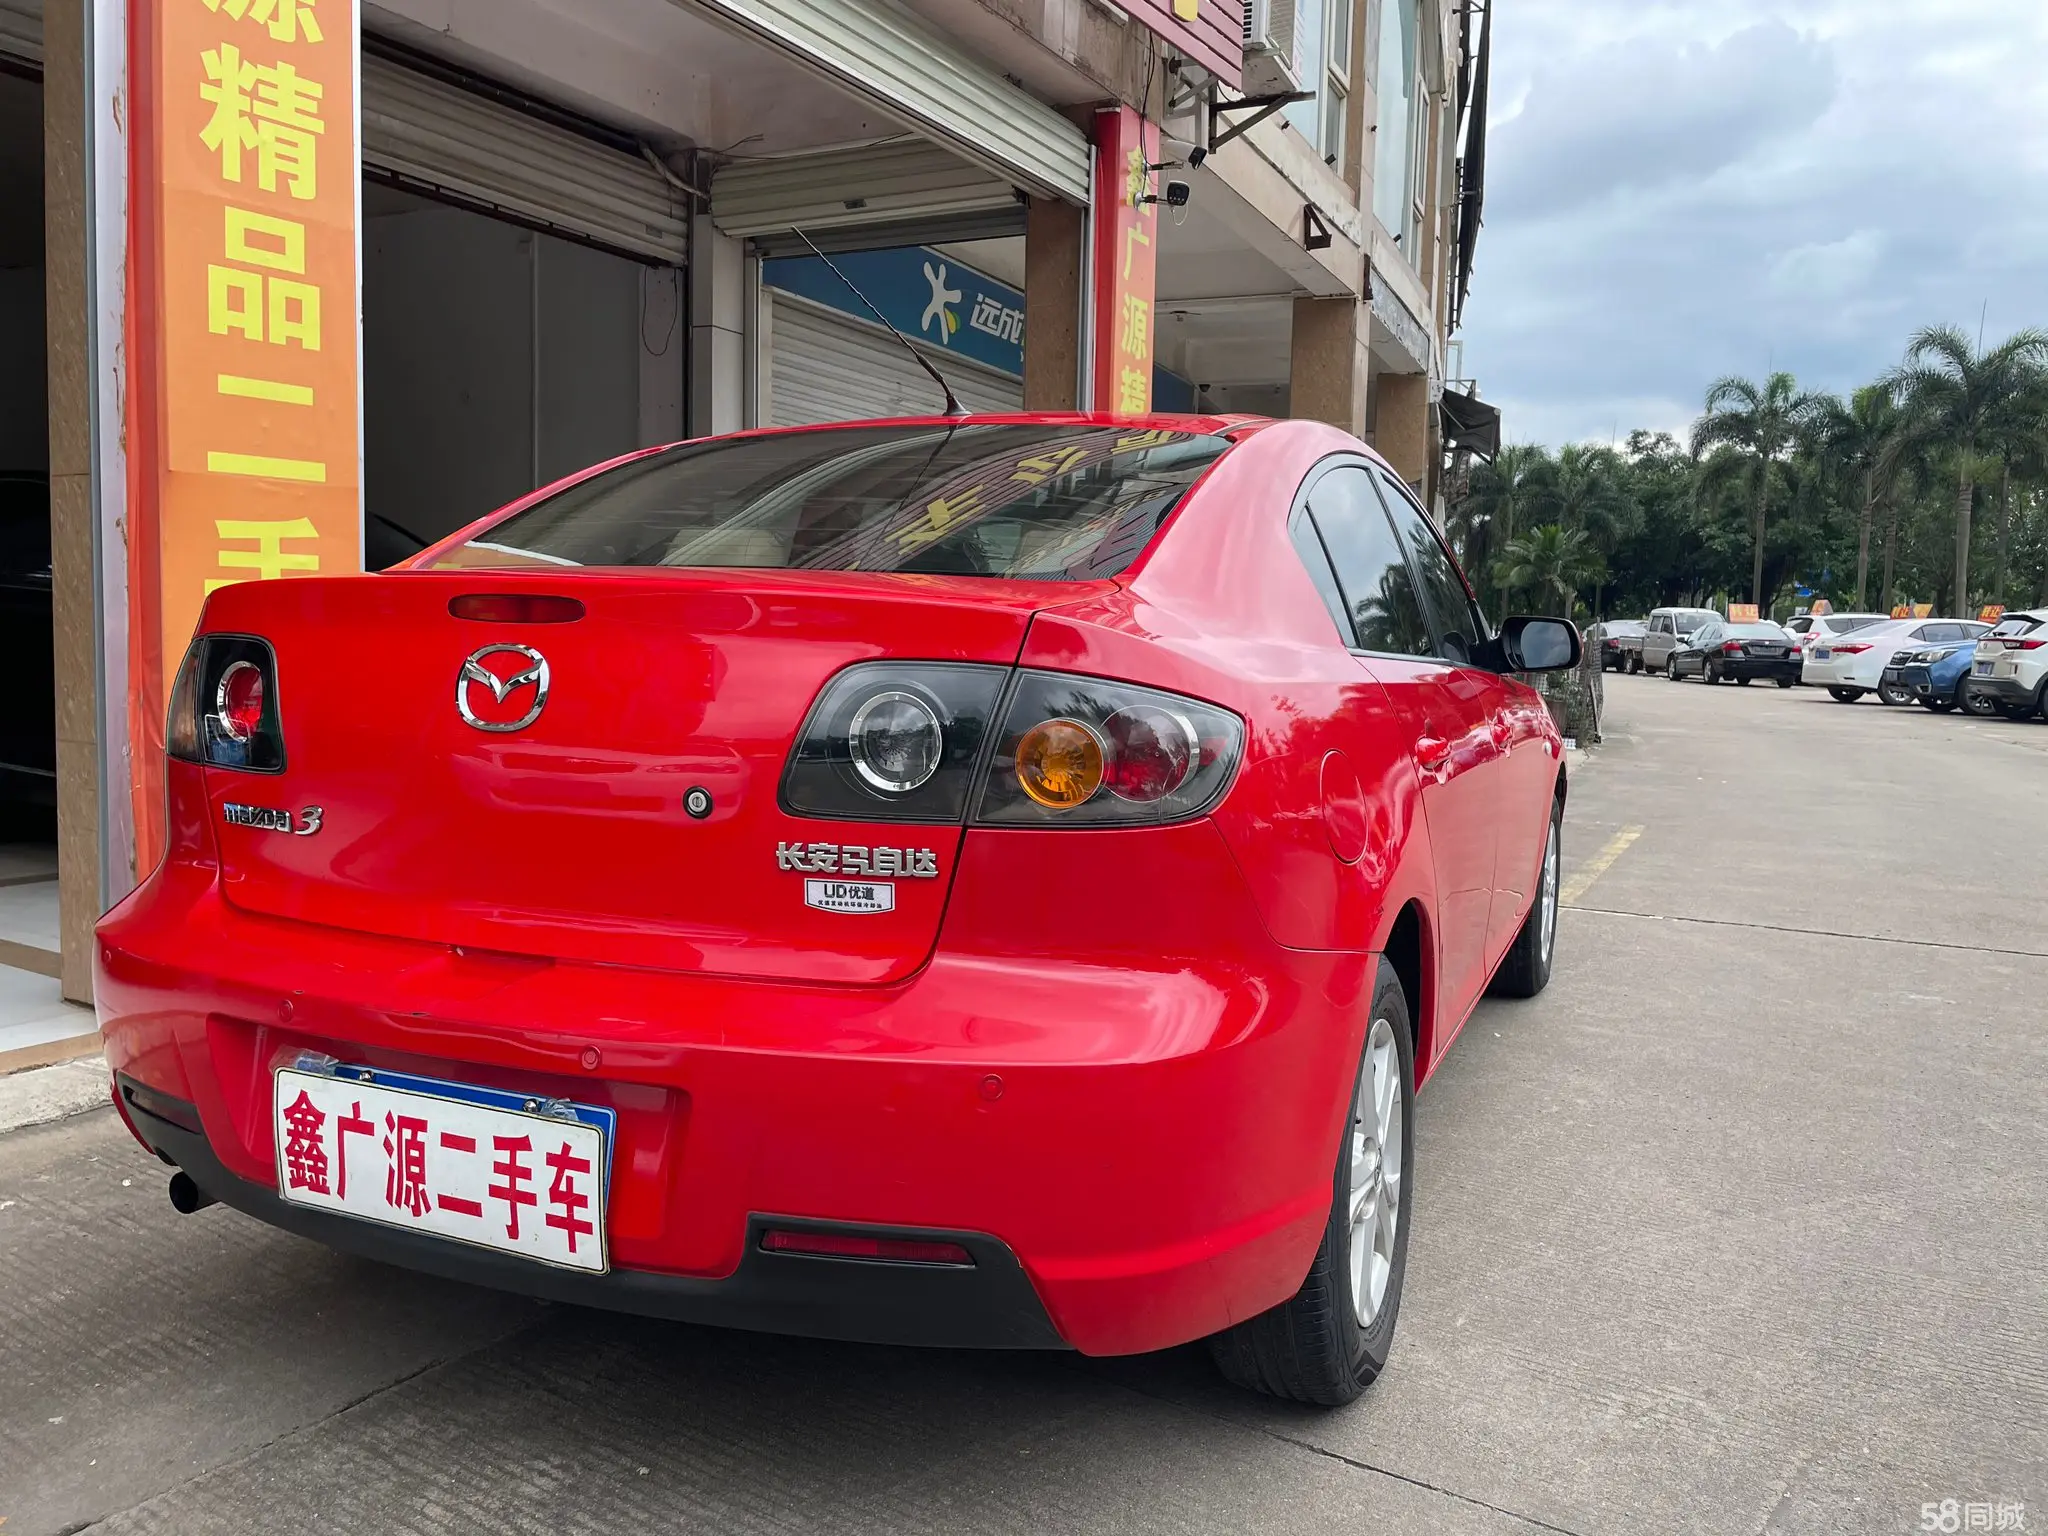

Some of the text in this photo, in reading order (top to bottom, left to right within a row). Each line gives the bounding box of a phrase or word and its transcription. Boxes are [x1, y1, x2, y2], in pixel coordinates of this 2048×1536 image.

[294, 805, 323, 835] 3
[776, 841, 939, 878] 长安马自达
[283, 1089, 594, 1254] 鑫广源二手车
